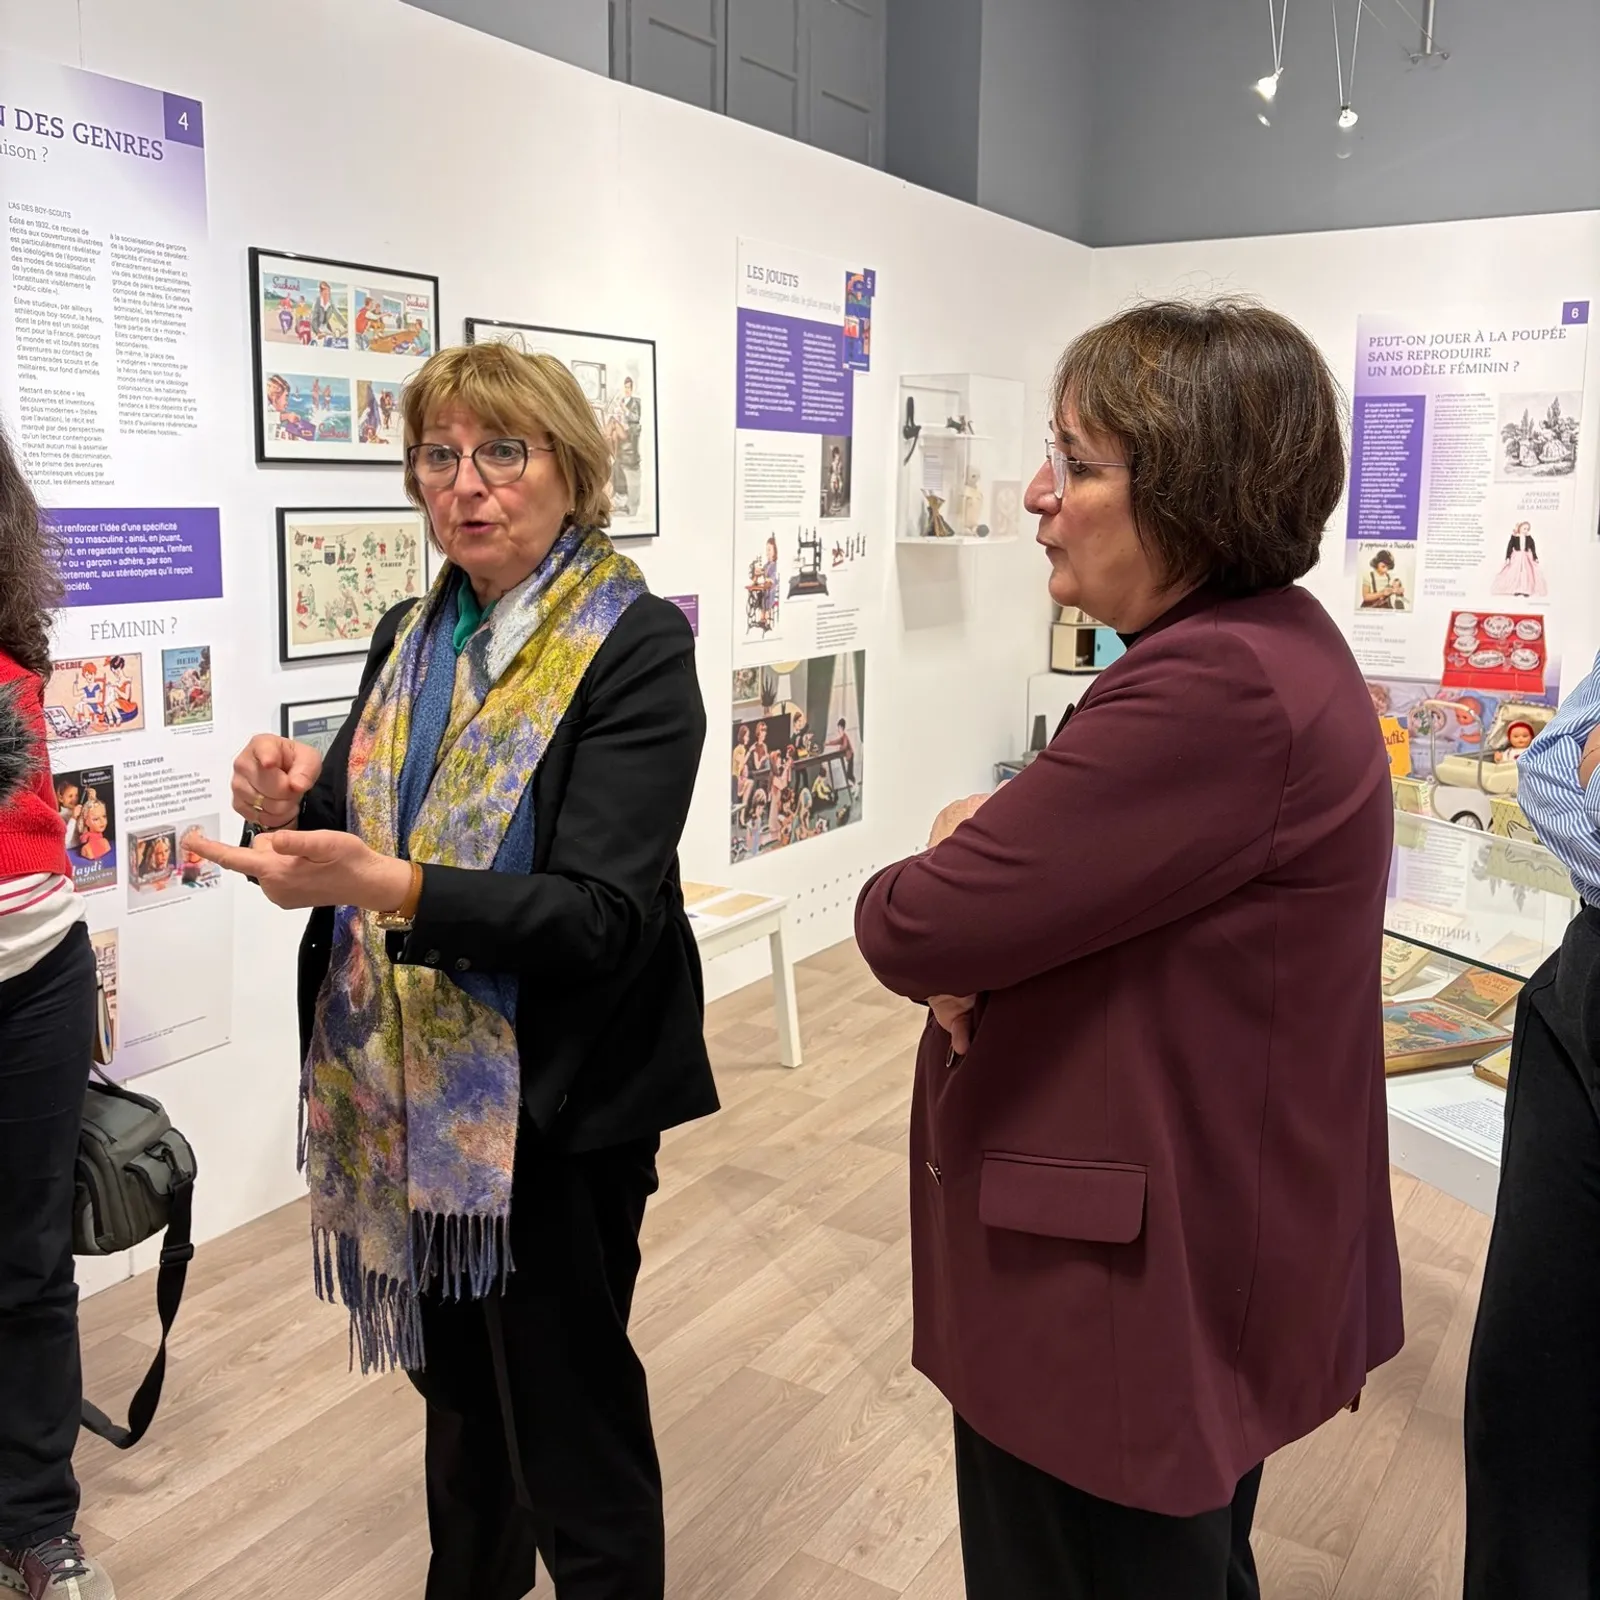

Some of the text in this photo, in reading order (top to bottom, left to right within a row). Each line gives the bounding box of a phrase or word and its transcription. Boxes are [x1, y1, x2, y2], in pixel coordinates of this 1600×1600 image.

[177, 112, 189, 131] 4
[15, 108, 64, 139] DES
[73, 122, 164, 161] GENRES
[747, 264, 799, 288] LES JOUETS
[1571, 308, 1579, 318] 6
[1369, 325, 1567, 347] PEUT-ON JOUER À LA POUPÉE
[1368, 347, 1492, 363] SANS REPRODUIRE
[1368, 360, 1520, 378] UN MODÈLE FÉMININ ?
[64, 524, 99, 532] renforcer
[99, 524, 121, 532] l'idée
[120, 524, 142, 532] d'une
[141, 523, 180, 533] spécificité
[85, 534, 124, 543] masculine
[128, 534, 149, 545] ainsi,
[157, 534, 185, 544] jouant,
[87, 545, 125, 557] regardant
[123, 545, 139, 554] des
[138, 544, 168, 556] images,
[166, 544, 194, 553] l'enfant
[86, 559, 113, 569] garçon
[117, 556, 147, 568] adhère,
[146, 558, 160, 567] par
[101, 570, 115, 578] aux
[115, 566, 159, 580] stéréotypes
[157, 566, 176, 578] qu'il
[172, 565, 196, 578] reçoit
[90, 617, 178, 640] FÉMININ ?
[1384, 730, 1405, 746] utils
[123, 760, 136, 768] TÊTE
[142, 757, 164, 766] COIFFER
